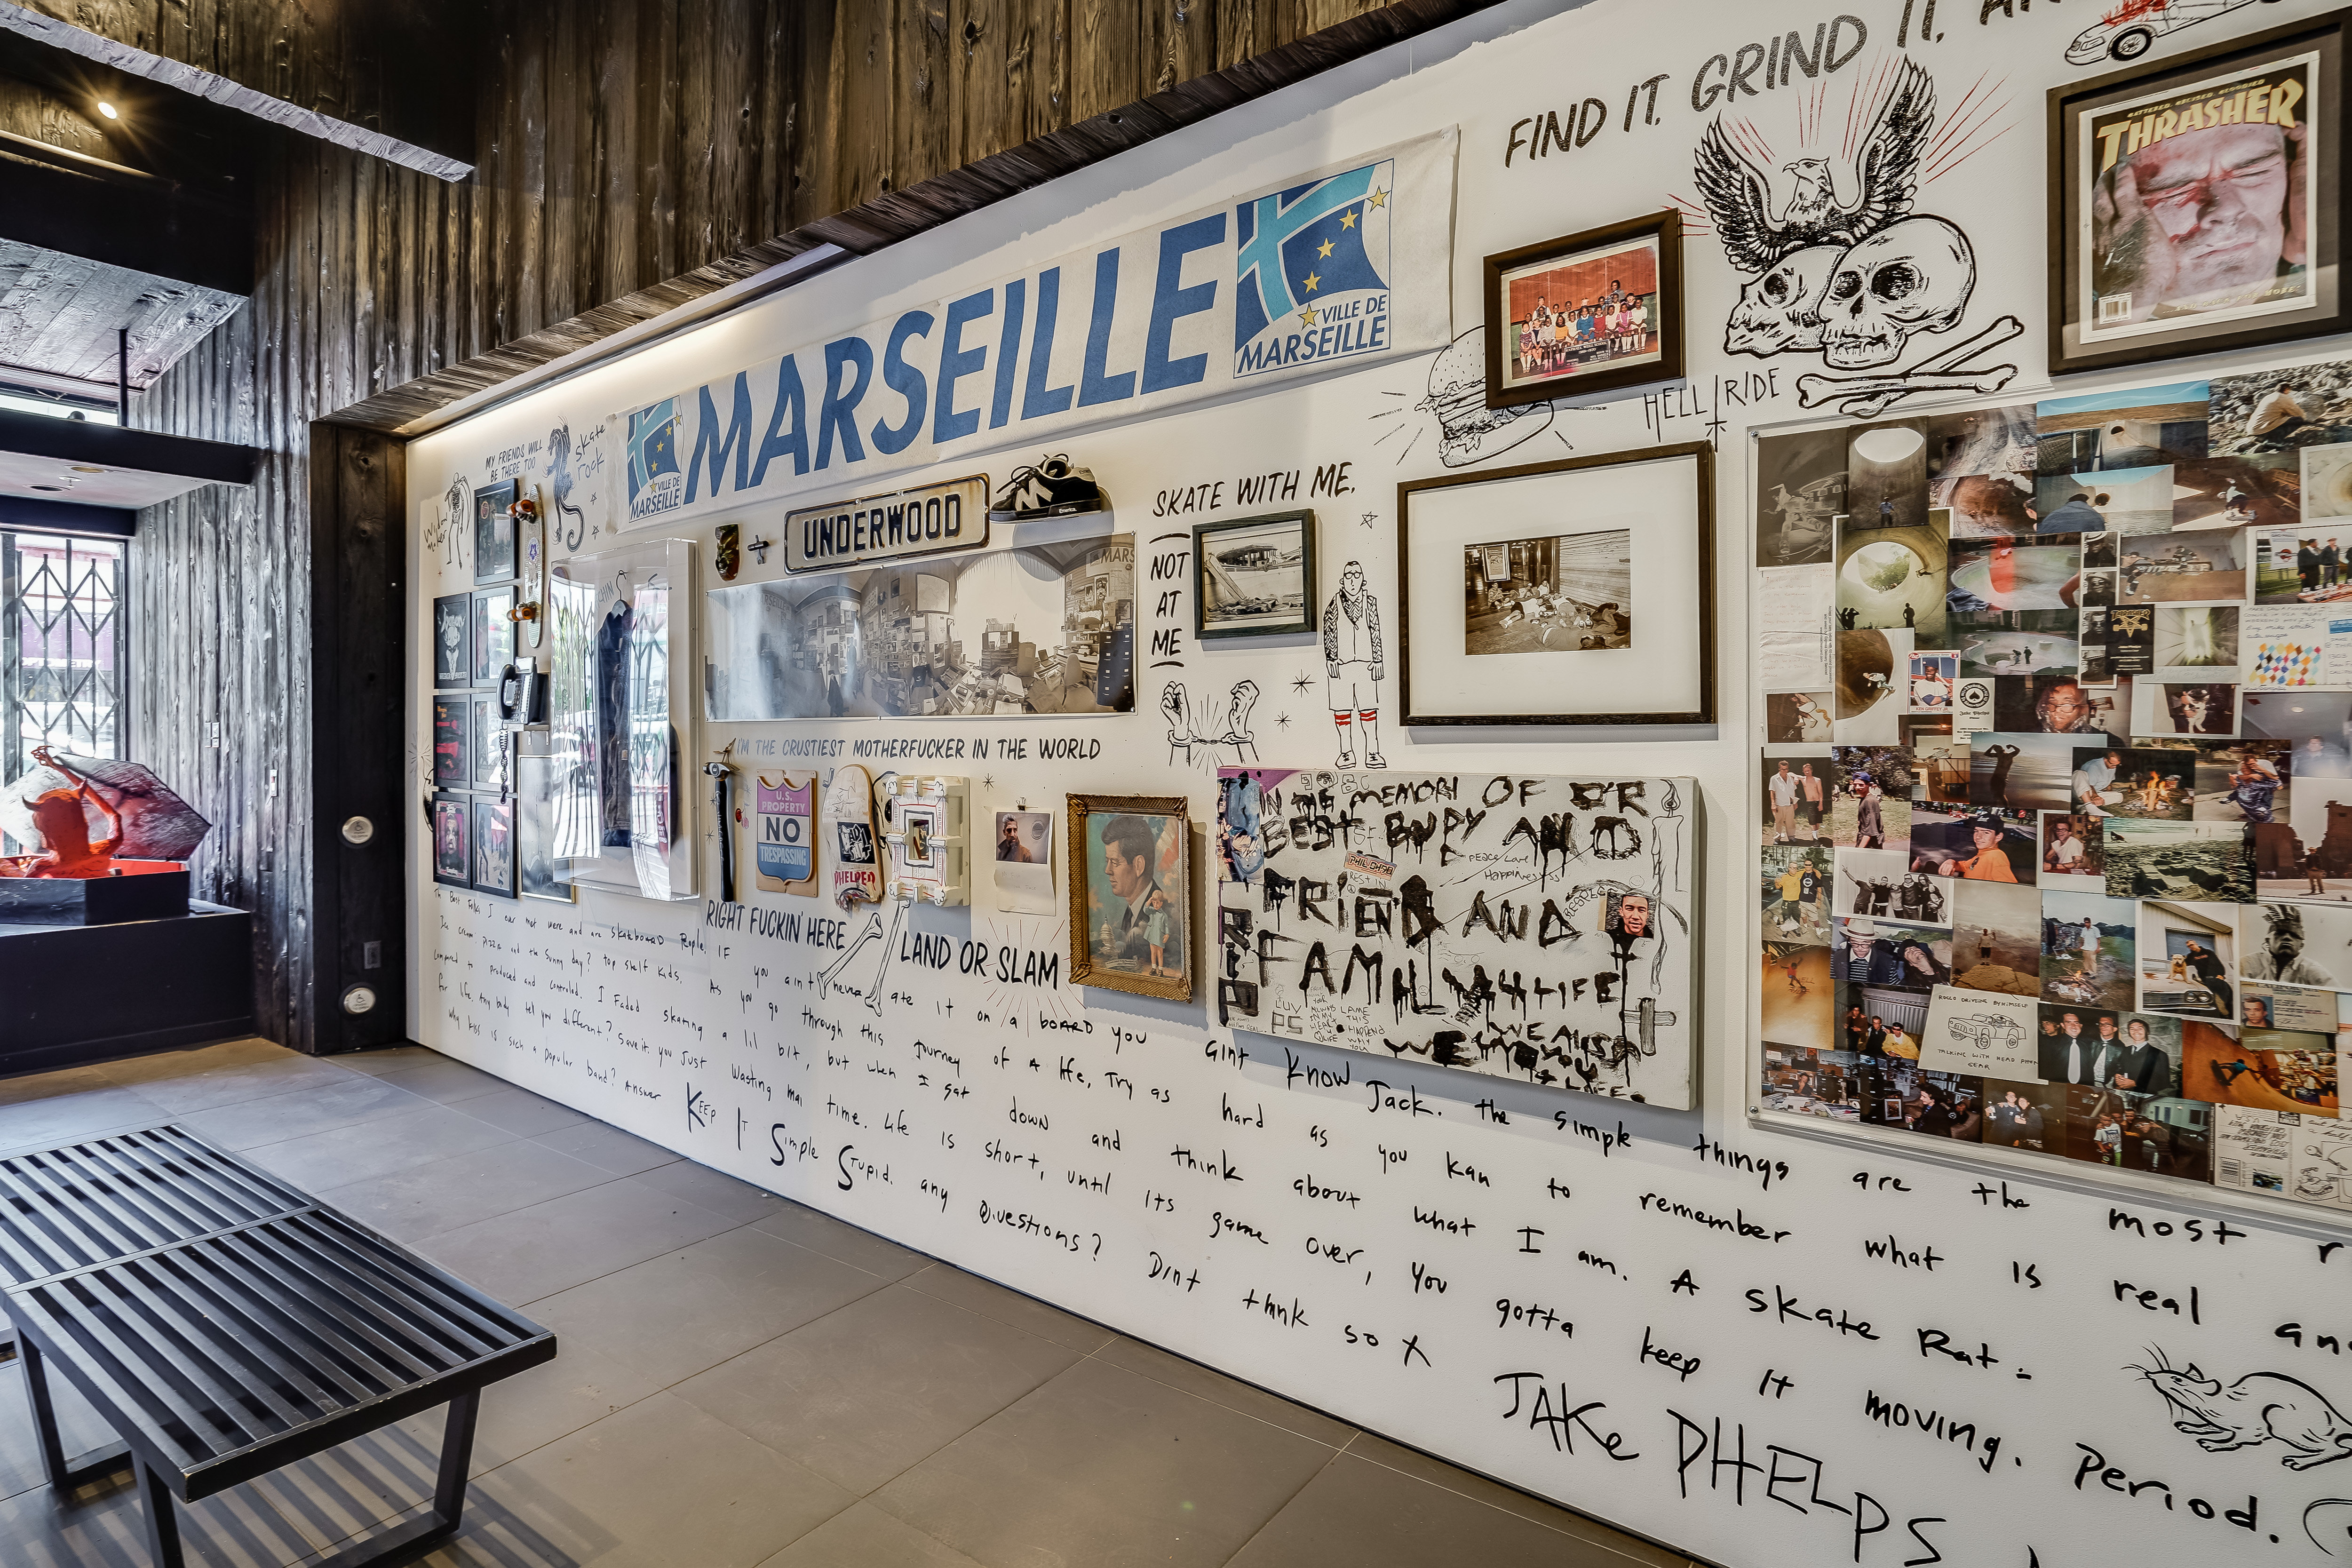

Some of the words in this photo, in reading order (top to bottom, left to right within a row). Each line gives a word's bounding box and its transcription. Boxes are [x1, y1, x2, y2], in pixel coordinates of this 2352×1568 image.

[1505, 97, 1607, 169] FIND
[1692, 14, 1868, 111] GRIND
[2097, 78, 2304, 172] THRASHER
[1321, 300, 1360, 324] VILLE
[1366, 294, 1387, 315] DE
[683, 211, 1227, 505] MARSEILLE
[1237, 314, 1387, 374] MARSEILLE
[1644, 388, 1708, 442] HELL
[1725, 368, 1781, 406] RIDE
[485, 455, 495, 470] MY
[498, 444, 524, 465] FRIENDS
[528, 439, 543, 455] WILL
[490, 469, 498, 483] BE
[501, 461, 521, 479] THERE
[524, 456, 536, 472] TOO
[577, 447, 604, 481] rock
[657, 480, 670, 492] VILLE
[672, 477, 680, 488] DE
[1152, 481, 1225, 517] SKATE
[1237, 470, 1300, 506] WITH
[630, 490, 680, 521] MARSEILLE
[803, 493, 961, 562] UNDERWOOD
[1150, 551, 1191, 581] NOT
[1156, 590, 1183, 619] AT
[1151, 628, 1183, 657] ME
[736, 738, 752, 756] I'M
[757, 740, 776, 756] THE
[782, 739, 846, 757] CRUSTIEST
[853, 738, 965, 759] MOTHERFUCKER
[972, 738, 989, 760] IN
[997, 738, 1028, 761] THE
[1039, 738, 1101, 760] WORLD
[762, 802, 805, 813] PROPERTY
[776, 791, 792, 800] U.S.
[766, 817, 800, 843] NO
[760, 846, 806, 866] TRESPASSING
[706, 899, 746, 931] RIGHT
[750, 907, 803, 944] FUCKIN'
[806, 916, 847, 951] HERE
[900, 930, 952, 971] LAND
[959, 939, 988, 977] OR
[996, 946, 1058, 991] SLAM
[1341, 1006, 1371, 1016] LAME
[1346, 1015, 1369, 1024] THIS
[450, 891, 460, 905] Best
[488, 903, 493, 918] I
[525, 917, 537, 929] met
[548, 921, 563, 931] were
[569, 921, 582, 935] and
[754, 965, 768, 989] you
[784, 971, 814, 991] aint
[890, 991, 914, 1006] ate
[977, 1010, 990, 1023] on
[1111, 1026, 1147, 1055] you
[1365, 1079, 1443, 1118] Jack.
[1474, 1098, 1511, 1126] the
[1693, 1132, 1790, 1192] things
[1852, 1172, 1912, 1192] are
[1971, 1181, 2030, 1209] the
[2108, 1207, 2248, 1246] most
[511, 943, 520, 955] and
[603, 953, 616, 971] top
[624, 959, 649, 973] shelf
[740, 990, 752, 1014] you
[768, 1002, 778, 1022] go
[801, 1004, 843, 1041] through
[860, 1023, 883, 1047] this
[993, 1046, 1010, 1070] of
[1151, 1088, 1170, 1103] as
[1222, 1091, 1263, 1129] hard
[1310, 1125, 1328, 1148] as
[1378, 1144, 1407, 1175] you
[1546, 1177, 1570, 1200] to
[1638, 1193, 1792, 1243] remember
[1864, 1234, 1945, 1272] what
[2113, 1280, 2201, 1325] real
[524, 975, 535, 987] and
[597, 985, 604, 1003] I
[613, 994, 640, 1012] Faded
[827, 1050, 850, 1071] but
[866, 1059, 896, 1079] when
[918, 1074, 930, 1087] I
[944, 1083, 970, 1101] sat
[1091, 1129, 1121, 1152] and
[1170, 1144, 1244, 1182] think
[1293, 1173, 1361, 1210] about
[1414, 1205, 1477, 1237] what
[1517, 1226, 1545, 1254] I
[1578, 1250, 1628, 1281] am.
[1669, 1269, 1700, 1297] A
[541, 1010, 551, 1028] you
[659, 1046, 672, 1068] you
[1208, 1211, 1269, 1245] game
[1495, 1298, 1574, 1339] gotta
[1640, 1326, 1701, 1383] keep
[2073, 1441, 2280, 1545] Period.
[587, 1059, 616, 1087] band?
[625, 1080, 662, 1100] Answer
[921, 1179, 948, 1214] any
[1344, 1324, 1379, 1347] so
[1666, 1409, 1948, 1567] PHELPS
